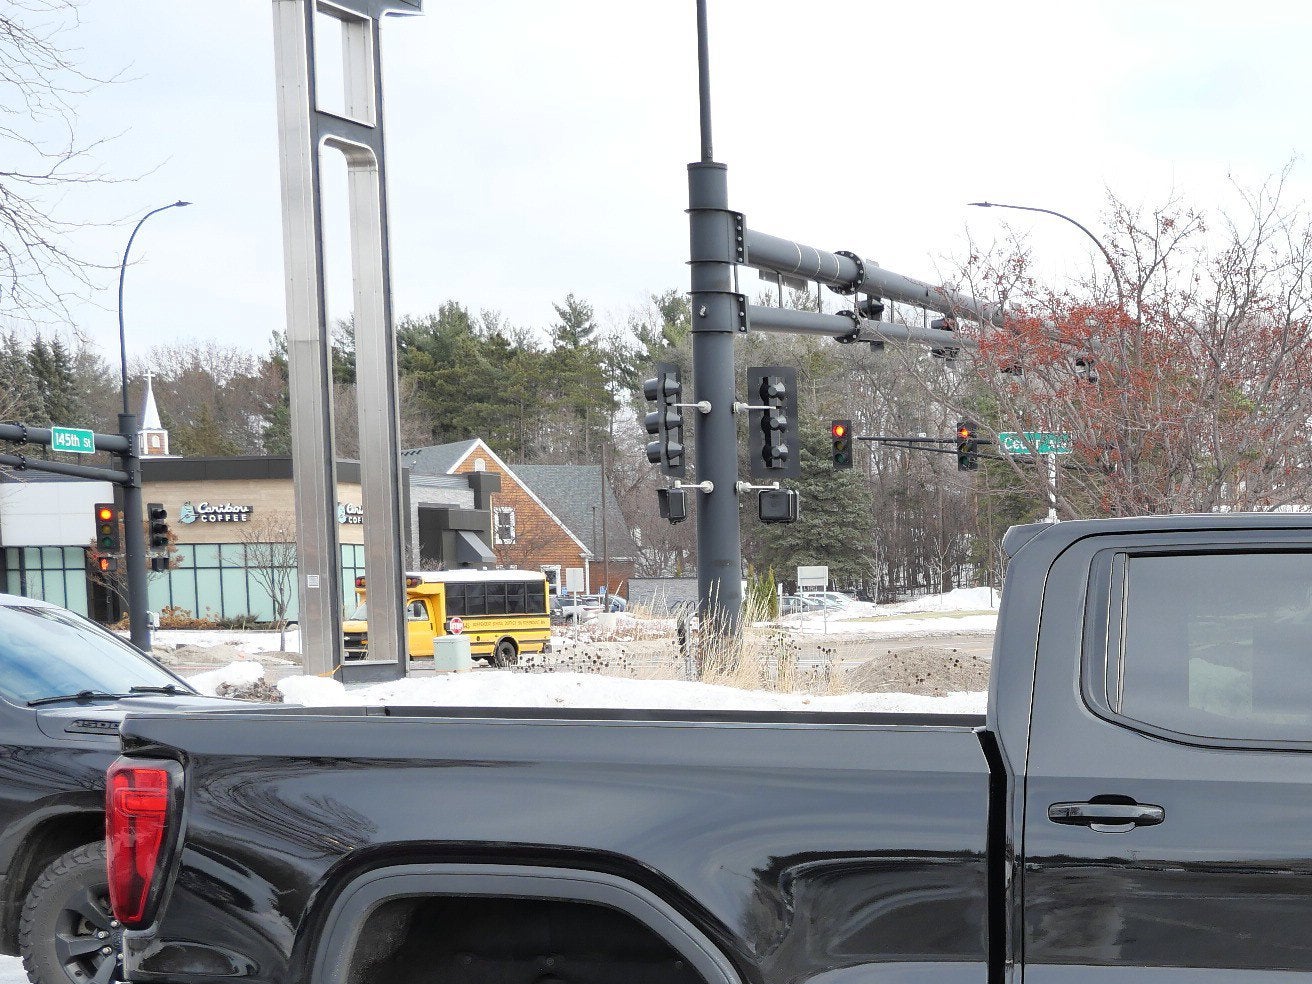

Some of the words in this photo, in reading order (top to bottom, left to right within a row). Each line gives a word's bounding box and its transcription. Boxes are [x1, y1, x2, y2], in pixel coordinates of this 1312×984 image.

[55, 432, 80, 447] 145th
[83, 437, 92, 447] St
[198, 502, 250, 513] Caribou
[201, 514, 247, 522] COFFEE
